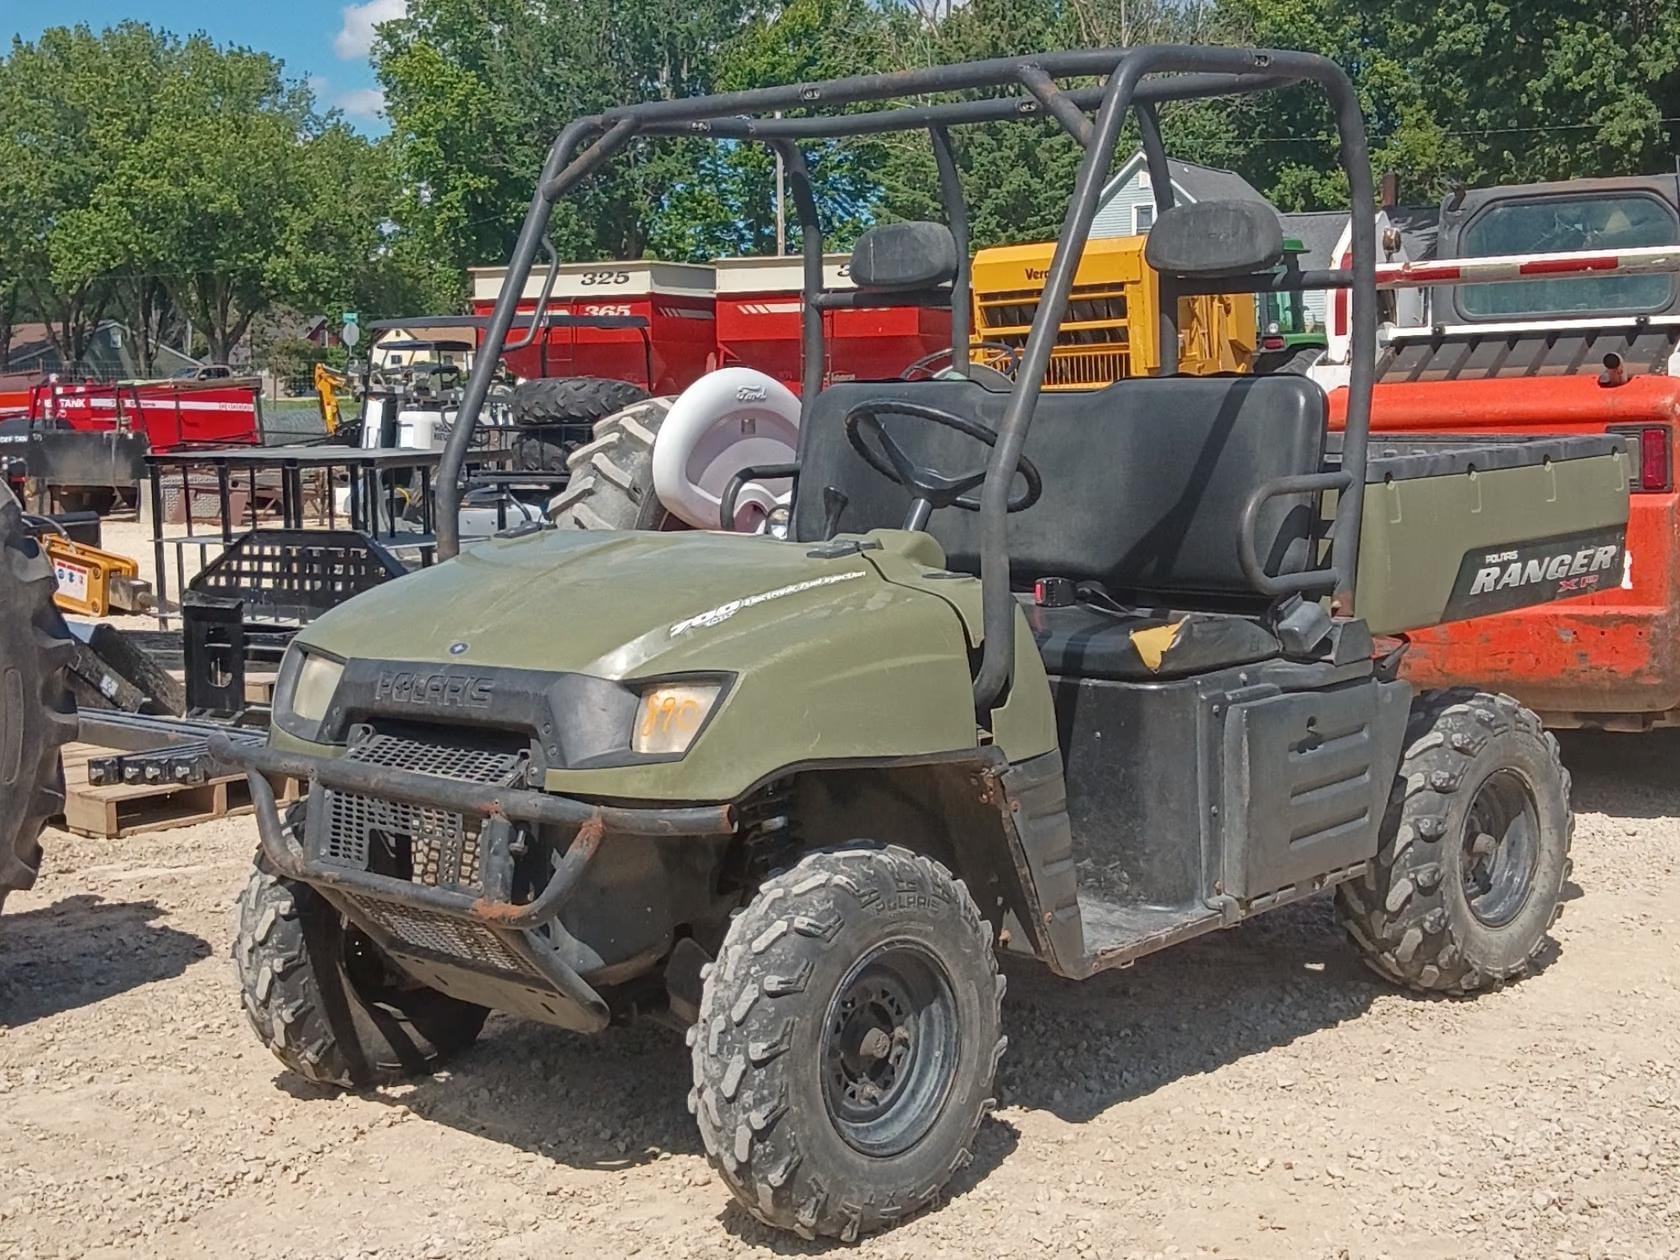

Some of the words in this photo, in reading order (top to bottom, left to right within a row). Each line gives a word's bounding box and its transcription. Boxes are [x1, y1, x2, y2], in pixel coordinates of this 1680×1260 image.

[580, 271, 630, 286] 325
[583, 304, 631, 316] 365
[736, 384, 767, 402] Ford
[59, 399, 86, 408] TANK
[1485, 550, 1519, 564] POLARIS
[1469, 545, 1617, 596] RANGER
[669, 599, 742, 638] 700
[375, 671, 497, 709] POLARIS
[875, 895, 940, 915] POLARIS
